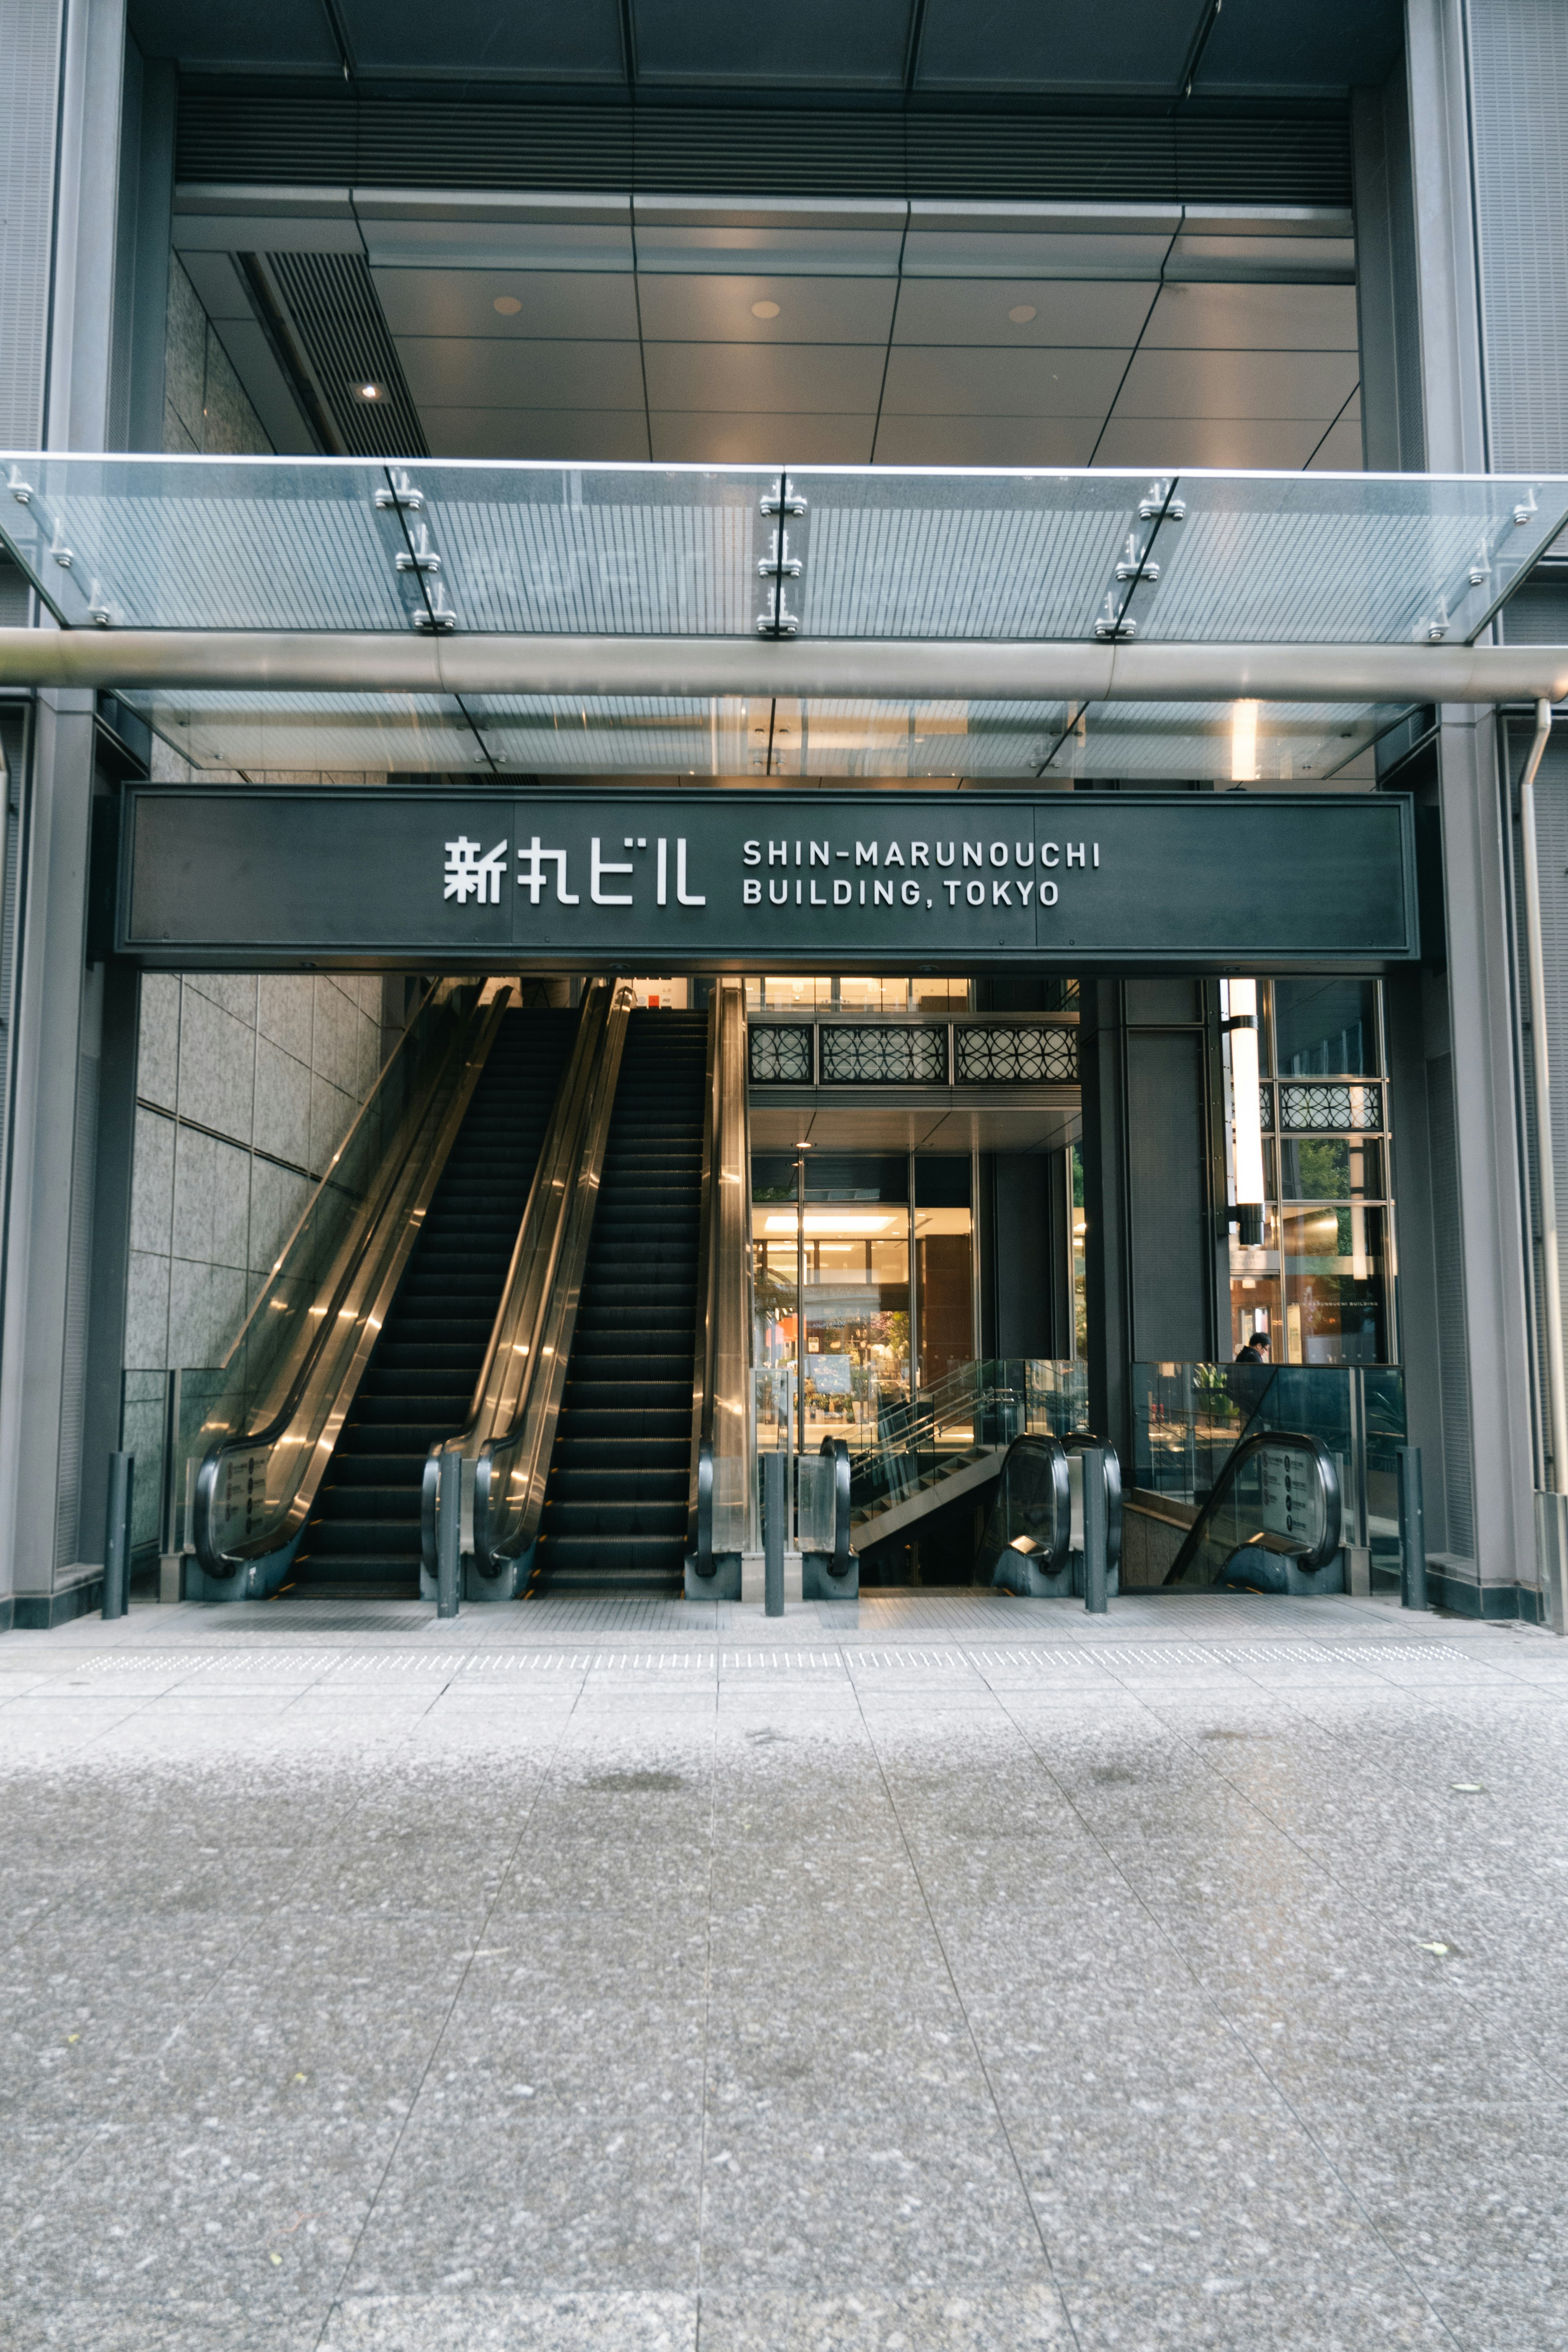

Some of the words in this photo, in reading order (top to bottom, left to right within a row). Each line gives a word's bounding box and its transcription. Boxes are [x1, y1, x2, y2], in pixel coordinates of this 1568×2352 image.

[743, 840, 1100, 867] SHIN-MARUNOUCHI
[444, 836, 706, 905] 新丸ビル
[743, 879, 932, 908] BUILDING,
[943, 880, 1059, 906] TOKYO
